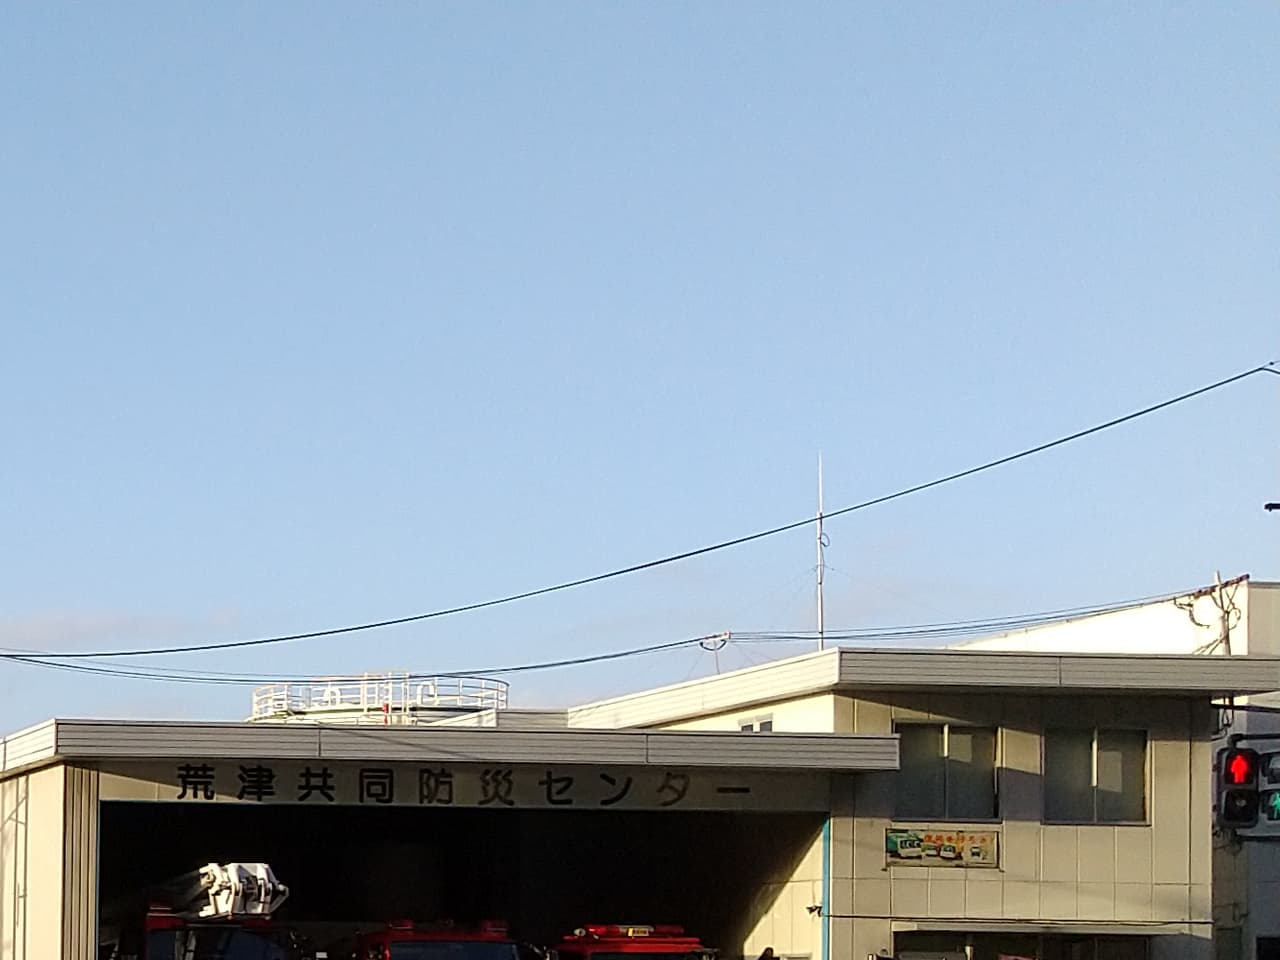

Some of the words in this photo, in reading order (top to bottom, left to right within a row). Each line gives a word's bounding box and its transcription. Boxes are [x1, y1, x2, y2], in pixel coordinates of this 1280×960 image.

[176, 764, 752, 807] 荒津共同防災センター
